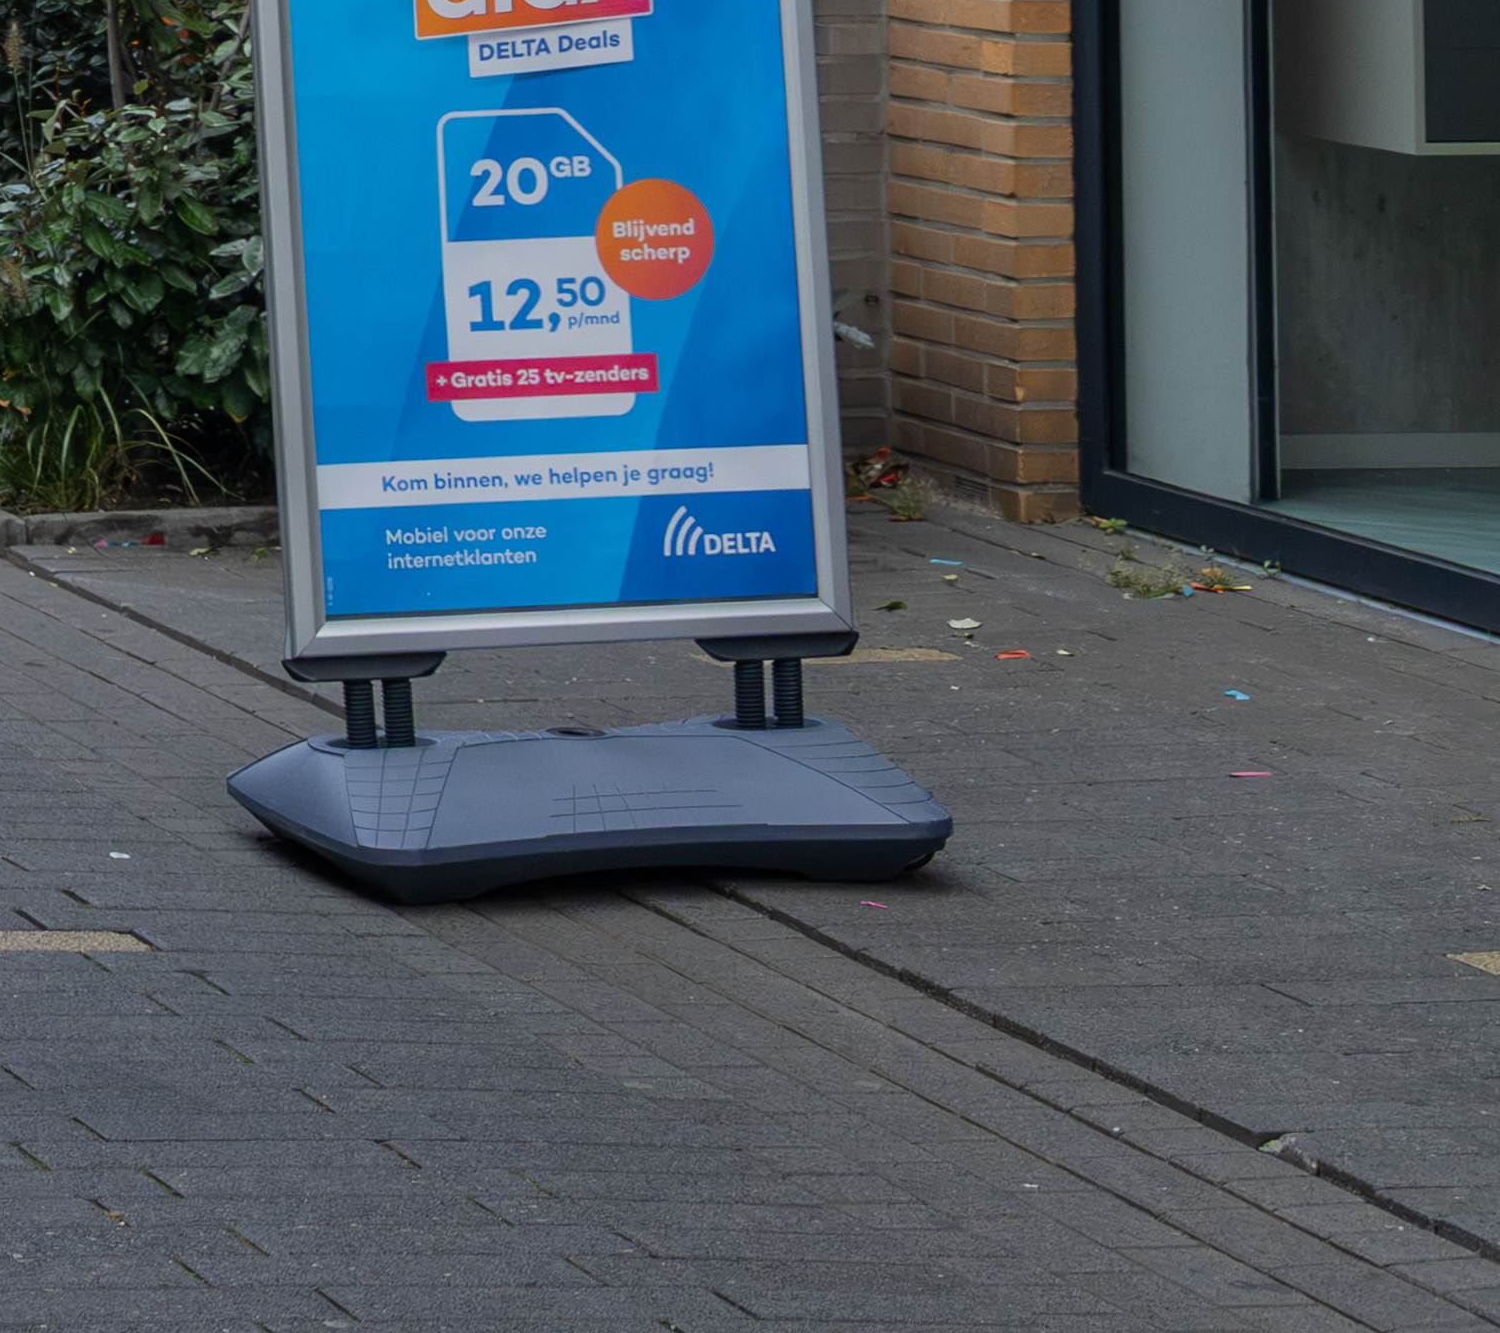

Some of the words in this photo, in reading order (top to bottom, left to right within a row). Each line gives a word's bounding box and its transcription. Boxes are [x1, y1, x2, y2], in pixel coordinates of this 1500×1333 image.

[478, 37, 551, 62] DELTA
[557, 30, 621, 54] Deals
[612, 218, 696, 243] Blijvend
[619, 244, 691, 265] scherp
[567, 310, 621, 330] p/mnd
[450, 369, 513, 390] Gratis
[516, 368, 540, 386] 25
[544, 364, 649, 385] tv-zenders
[381, 474, 428, 493] Kom
[433, 471, 509, 492] binnen,
[514, 473, 543, 487] we
[548, 466, 618, 491] helpen
[622, 465, 641, 487] je
[646, 462, 714, 484] graag!
[386, 527, 448, 545] Mobiel
[453, 527, 497, 542] voor
[501, 524, 547, 540] onze
[703, 530, 776, 556] DELTA
[387, 547, 537, 570] internetklanten
